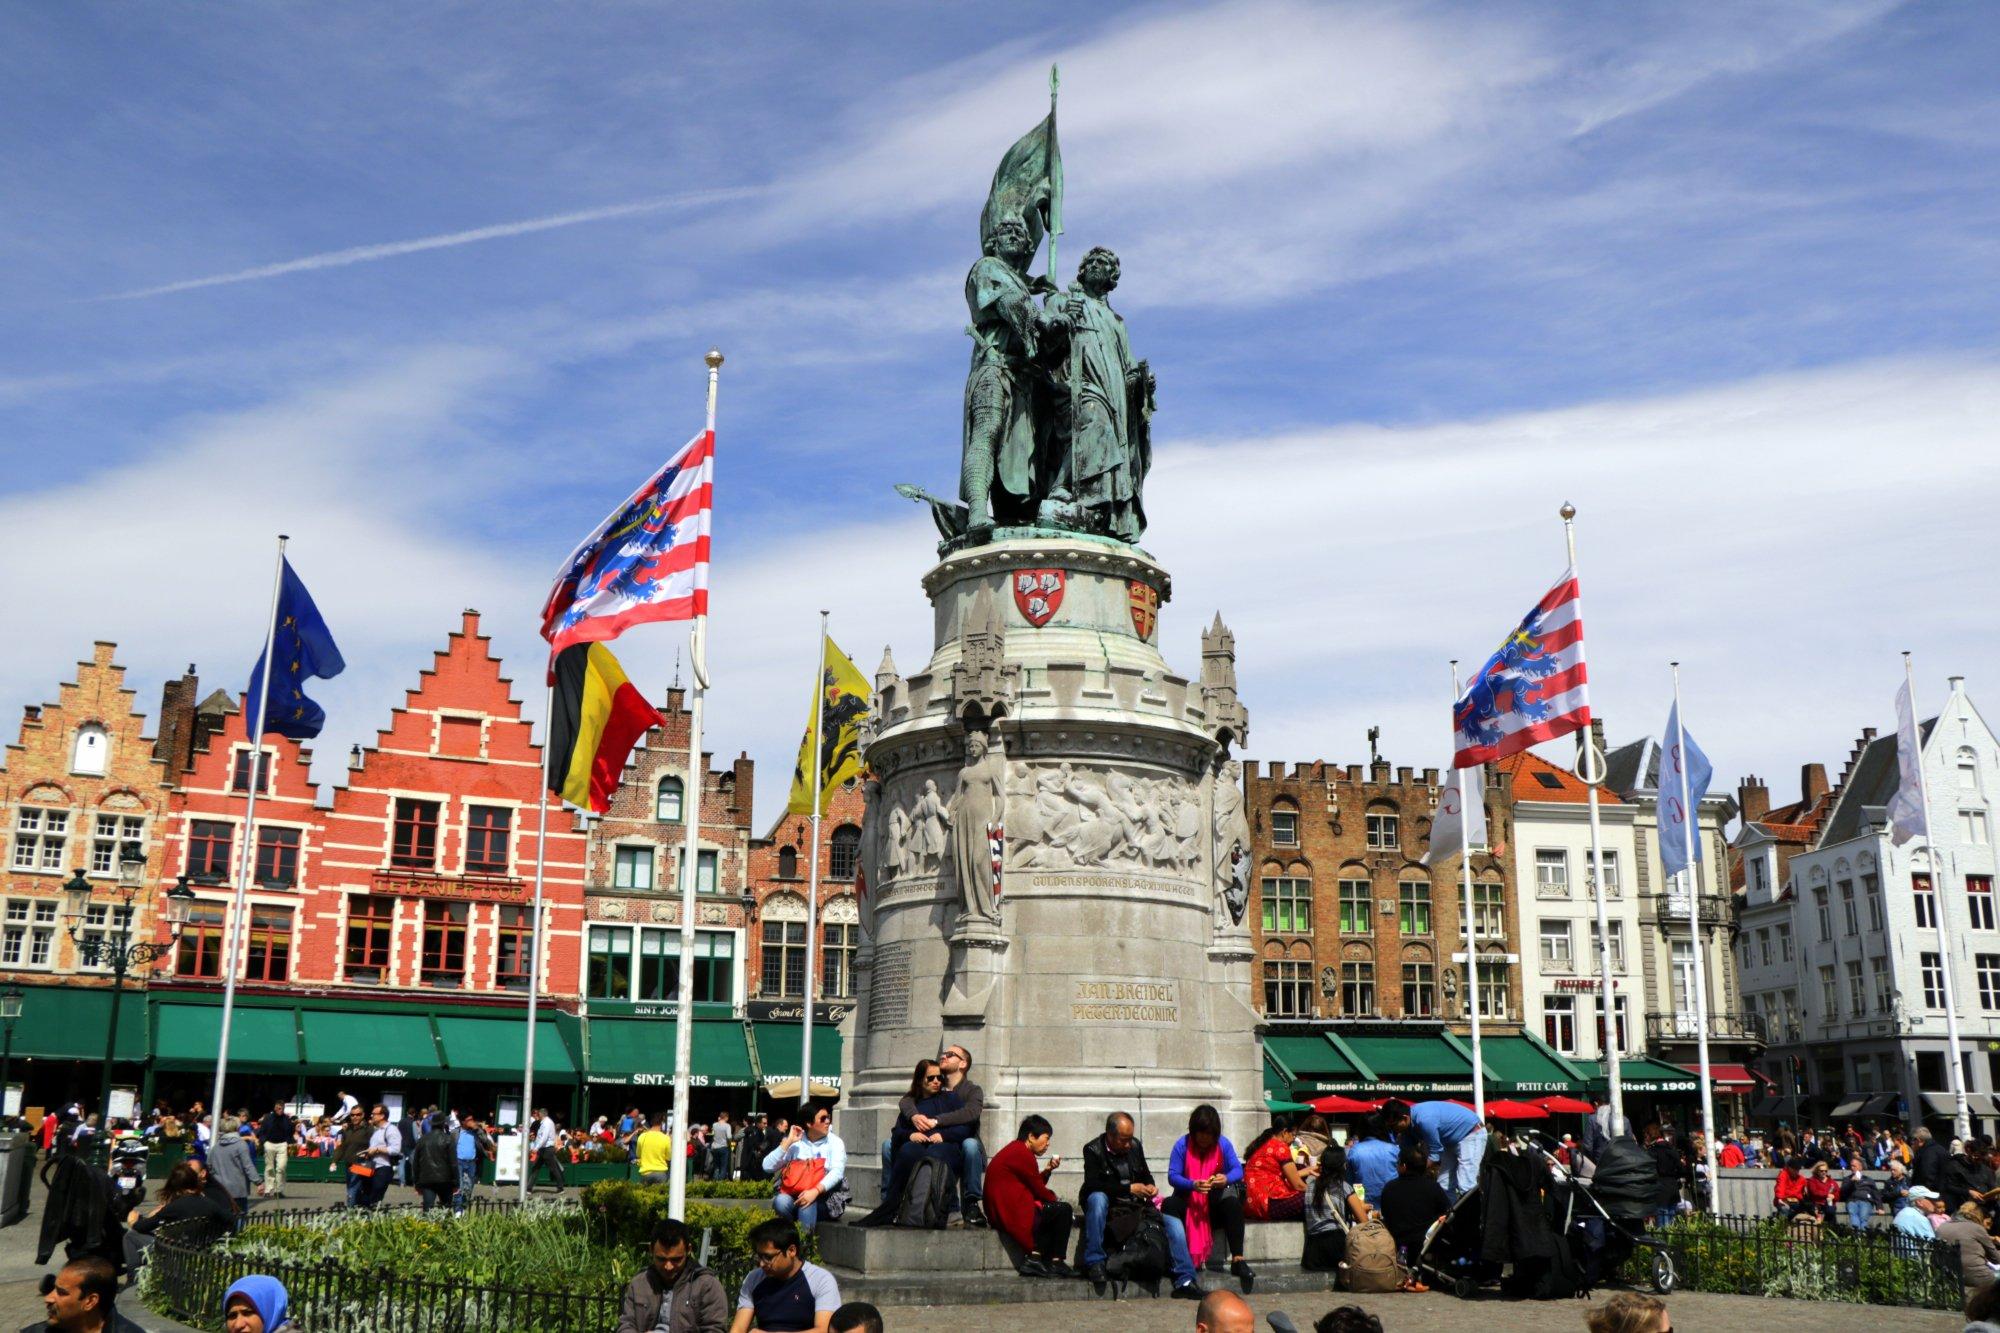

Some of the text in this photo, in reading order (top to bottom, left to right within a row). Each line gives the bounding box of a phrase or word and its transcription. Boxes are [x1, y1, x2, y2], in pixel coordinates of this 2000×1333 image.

[376, 880, 401, 892] LE
[406, 880, 475, 898] PANIER
[1116, 983, 1173, 1001] BREIDEL
[635, 1006, 679, 1016] SINT JOR
[340, 1067, 409, 1078] Le Panier d'Or
[588, 1073, 748, 1087] Restaurant SINT-JRIS Brasserie
[1316, 1083, 1358, 1091] Brasserie
[1364, 1083, 1375, 1091] La
[1407, 1083, 1424, 1091] d'Or
[1432, 1083, 1474, 1091] Restaurant
[1516, 1082, 1569, 1091] PETIT CAFE
[1661, 1081, 1697, 1091] 1900
